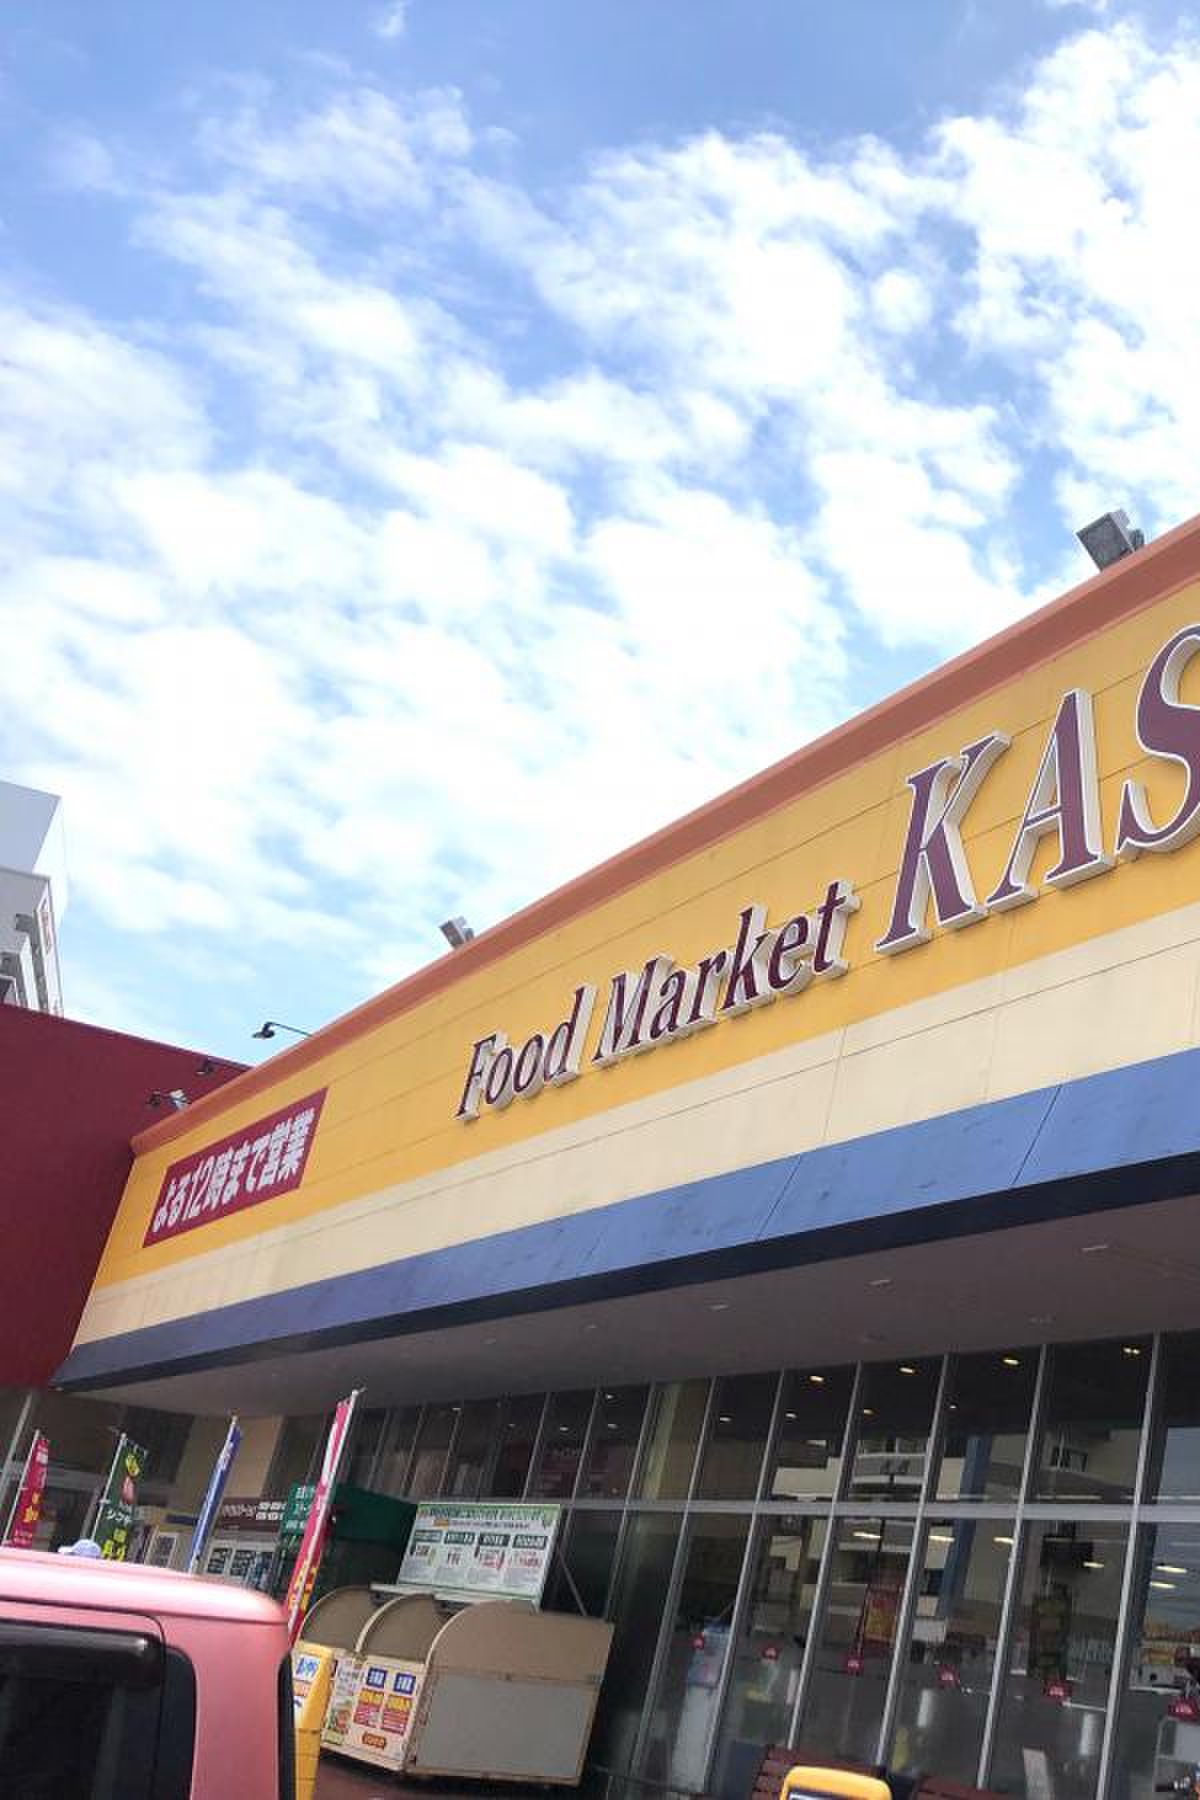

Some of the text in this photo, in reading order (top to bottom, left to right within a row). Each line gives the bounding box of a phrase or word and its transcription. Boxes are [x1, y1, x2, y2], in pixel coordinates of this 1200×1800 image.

[455, 984, 596, 1120] Food
[592, 880, 858, 1065] Market
[152, 1107, 316, 1233] よる12時まで営業
